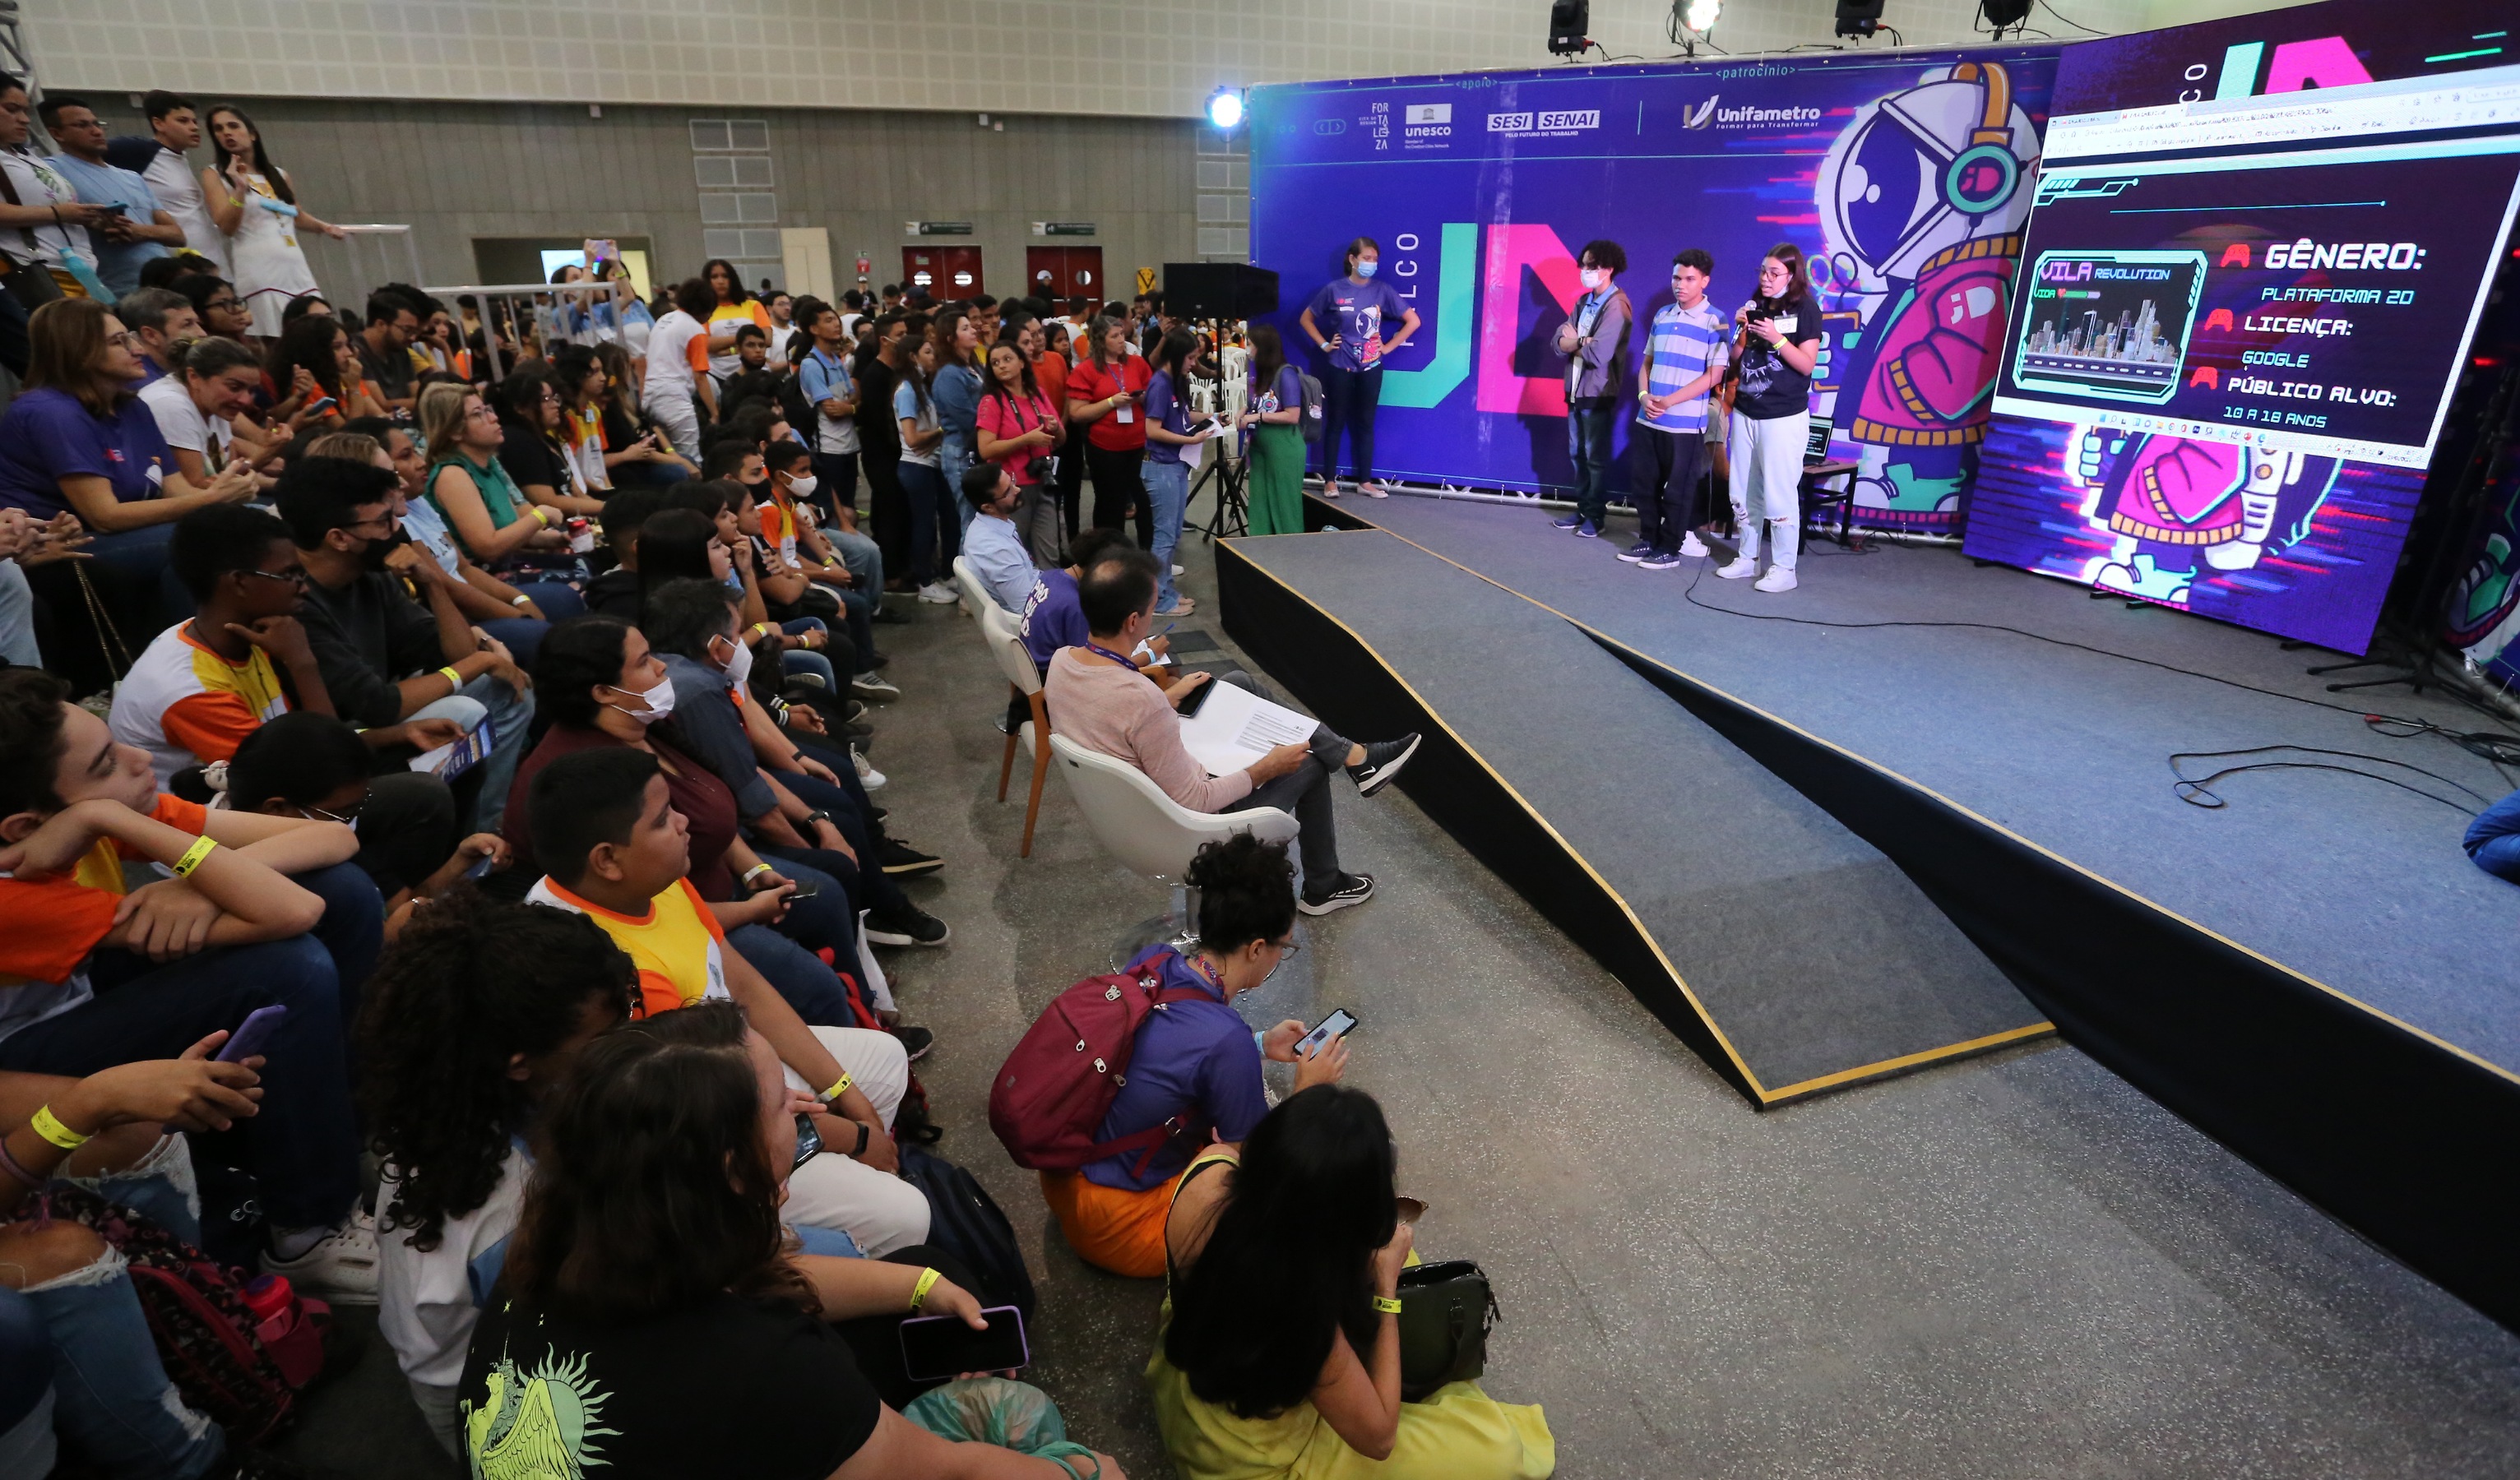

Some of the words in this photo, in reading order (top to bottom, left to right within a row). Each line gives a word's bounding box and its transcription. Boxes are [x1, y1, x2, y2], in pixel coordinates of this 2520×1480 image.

[1372, 103, 1389, 113] FOR
[1716, 105, 1821, 123] Unifametro
[1492, 115, 1528, 128] SESI
[1542, 113, 1595, 127] SENAI
[1405, 126, 1452, 137] unesco
[1375, 139, 1387, 150] ZA
[2264, 238, 2426, 270] GÊNERO:
[2040, 262, 2092, 281] VILA
[2094, 268, 2170, 280] REVOLUTION
[2262, 288, 2381, 303] PLATAFORMA
[2386, 290, 2415, 304] 2D
[2244, 316, 2353, 338] LICENÇA:
[2242, 350, 2309, 368] GOOGLE
[2227, 376, 2323, 400] PÚBLICO
[2329, 386, 2397, 407] ALVO:
[2223, 406, 2243, 419] 10
[2246, 409, 2258, 420] A
[2261, 410, 2281, 423] 18
[2285, 413, 2328, 428] ANOS
